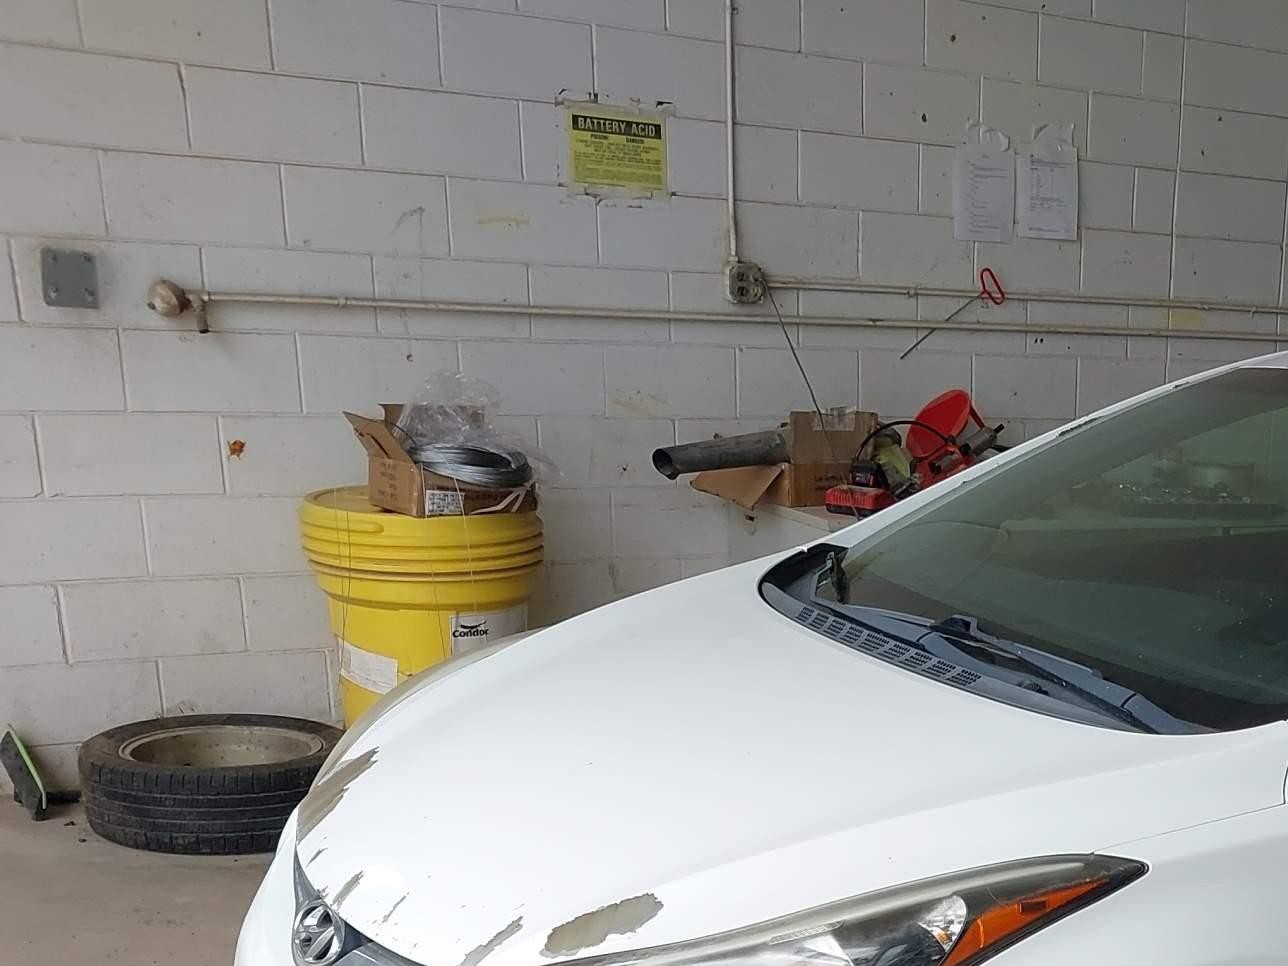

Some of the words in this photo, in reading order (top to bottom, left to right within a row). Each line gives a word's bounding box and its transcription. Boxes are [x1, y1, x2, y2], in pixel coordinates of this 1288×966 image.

[577, 117, 626, 133] BATTERY
[631, 124, 656, 137] ACID
[452, 628, 489, 639] Condor
